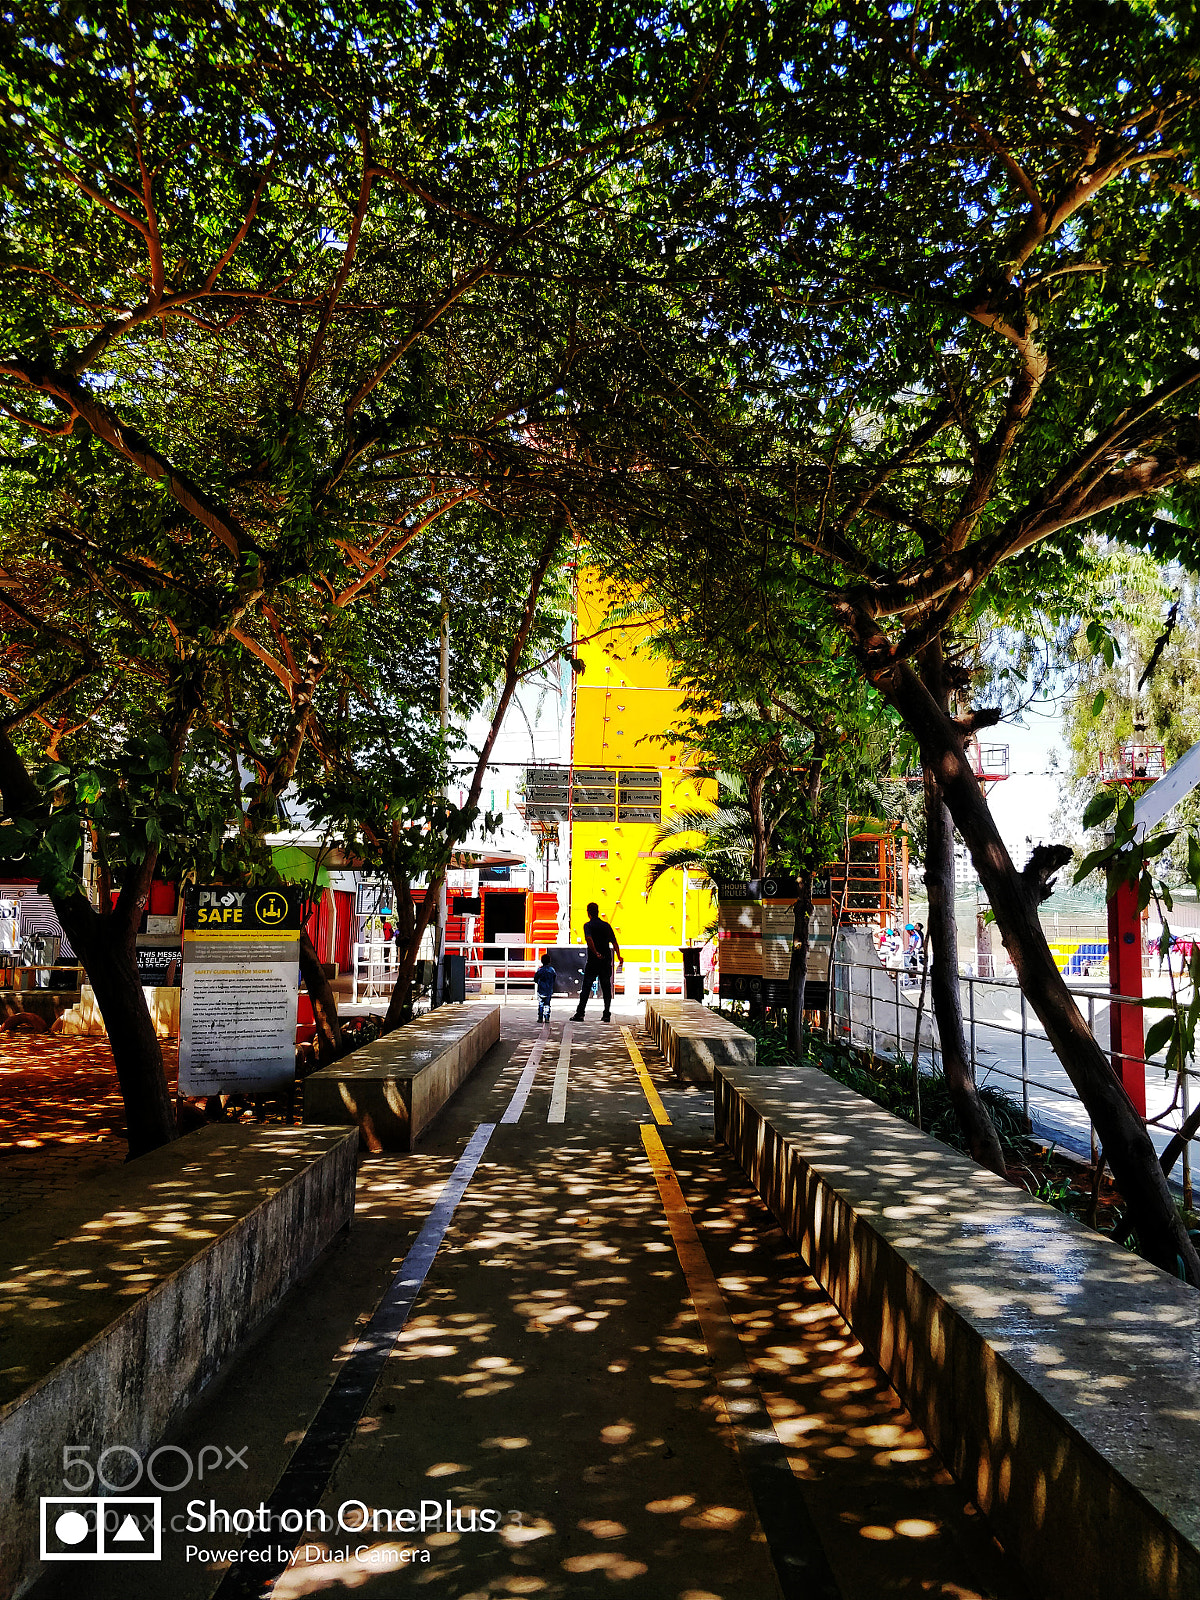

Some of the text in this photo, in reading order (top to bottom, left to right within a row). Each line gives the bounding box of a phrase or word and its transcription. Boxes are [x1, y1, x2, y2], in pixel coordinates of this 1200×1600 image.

[198, 891, 247, 907] PLAY
[724, 889, 747, 897] RULES
[197, 908, 243, 923] SAFE
